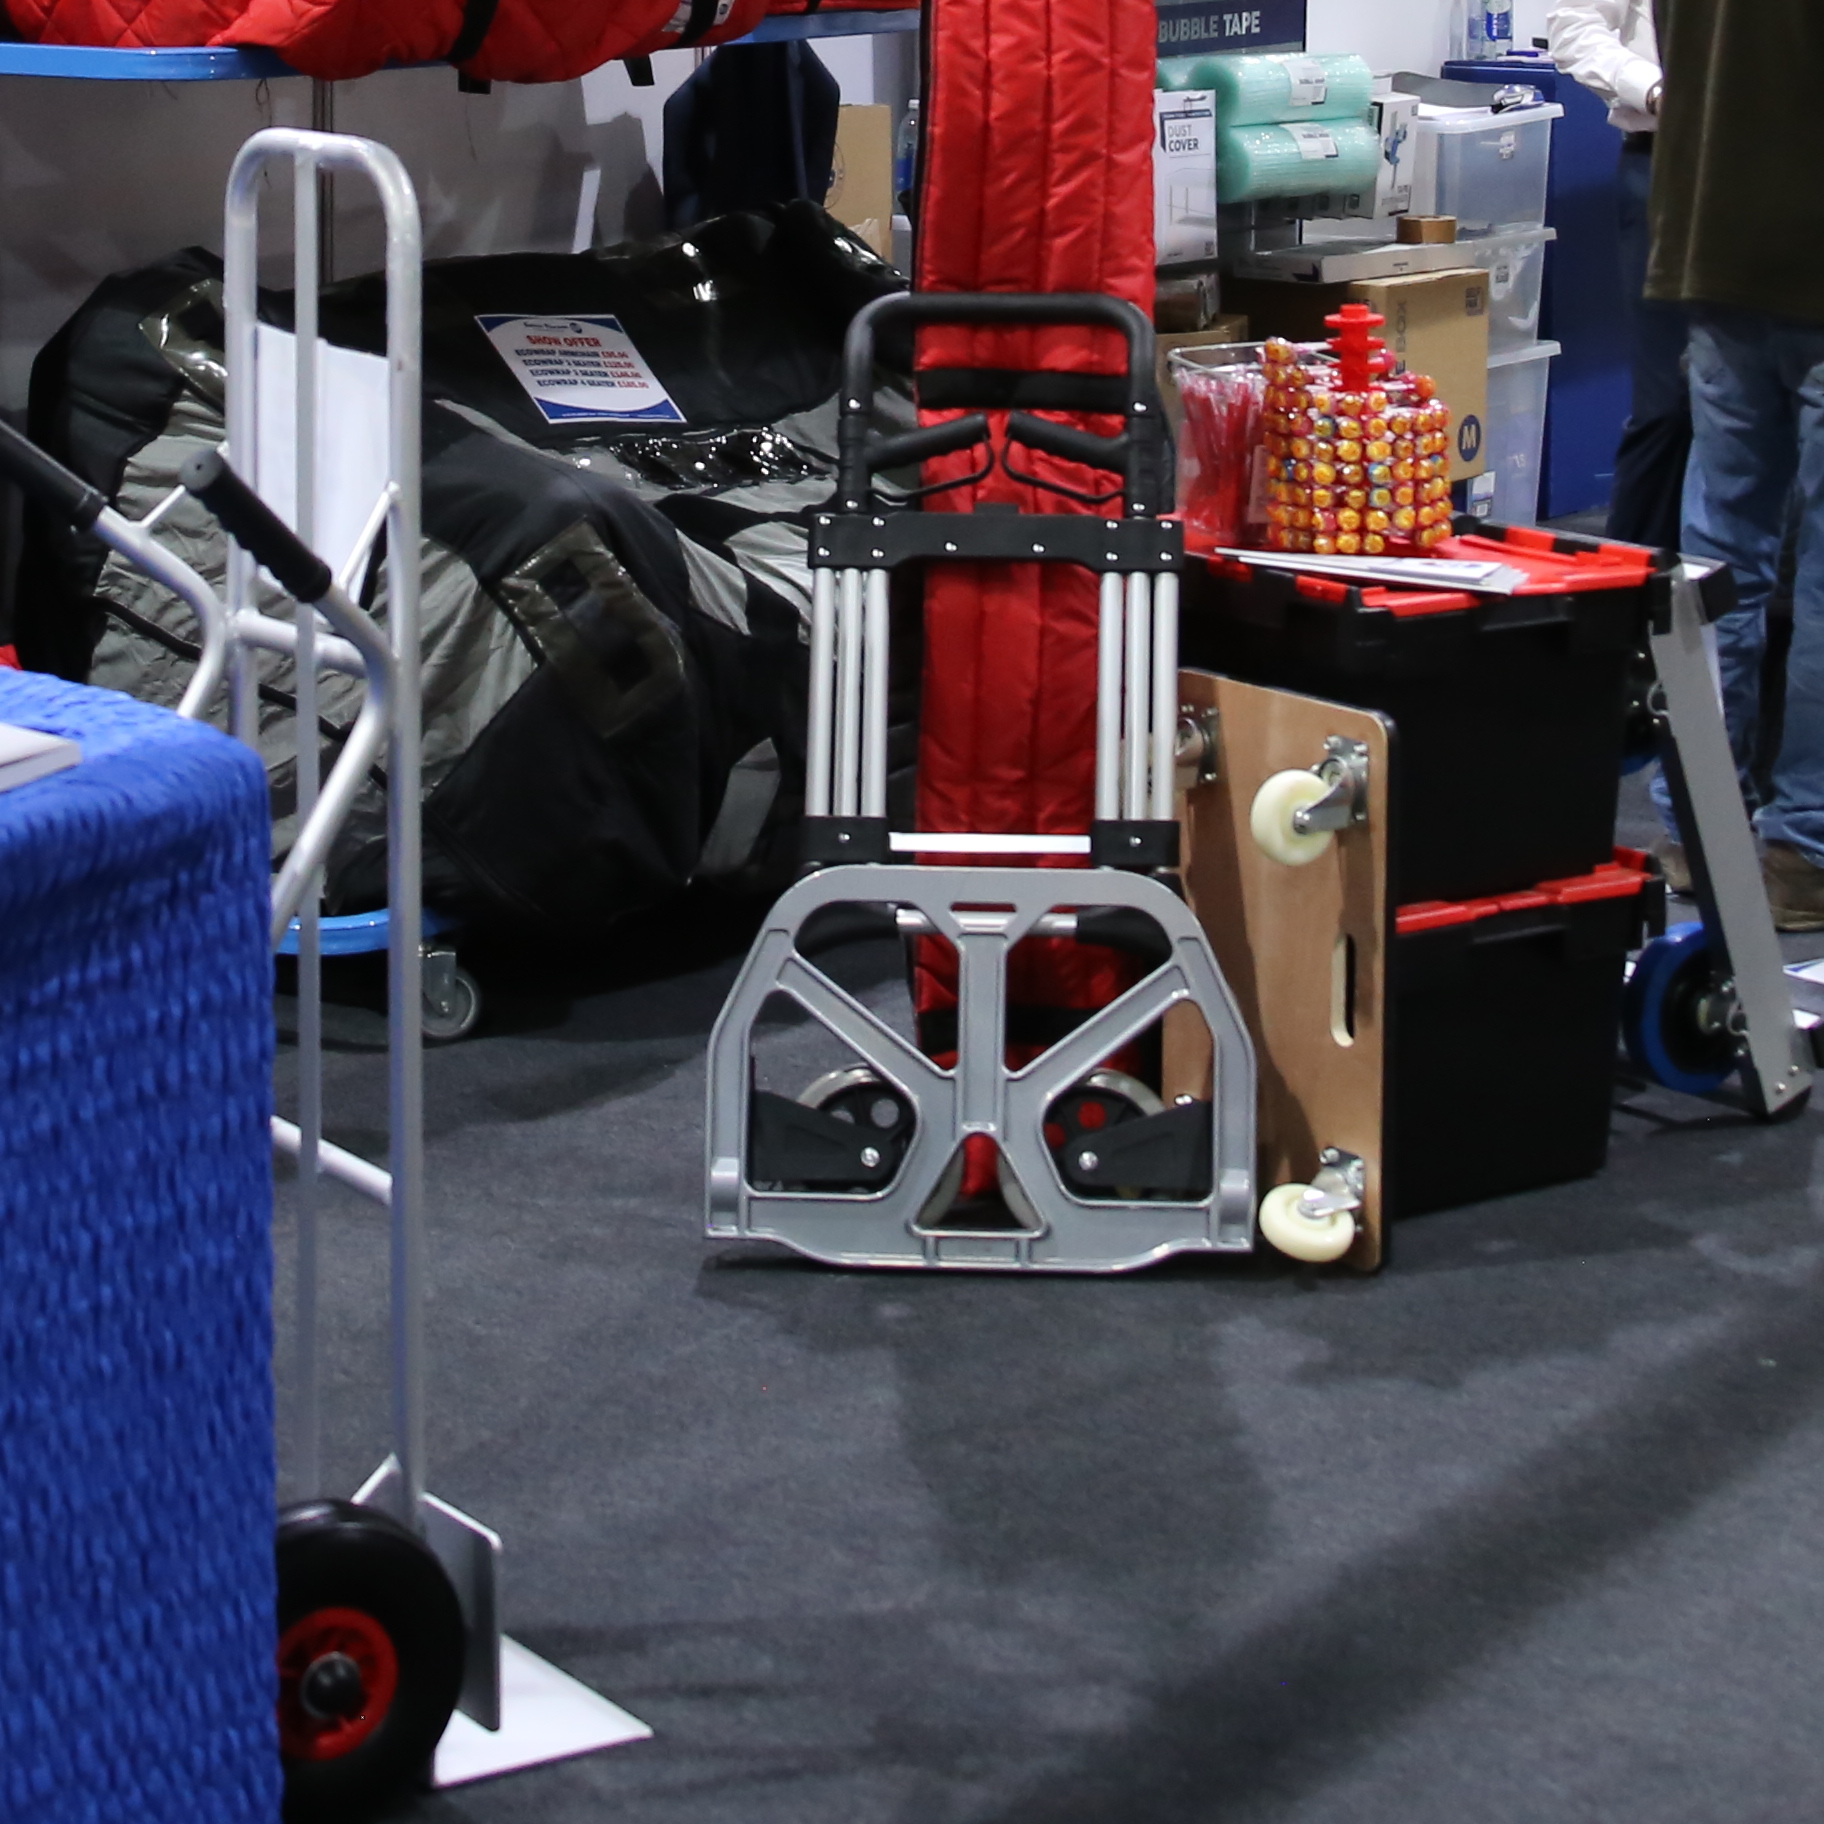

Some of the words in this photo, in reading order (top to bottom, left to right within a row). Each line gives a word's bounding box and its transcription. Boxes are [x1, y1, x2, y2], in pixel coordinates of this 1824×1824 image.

[1158, 15, 1220, 44] BUBBLE
[1222, 10, 1261, 38] TAPE
[1167, 124, 1193, 138] DUST
[1168, 138, 1200, 153] COVER
